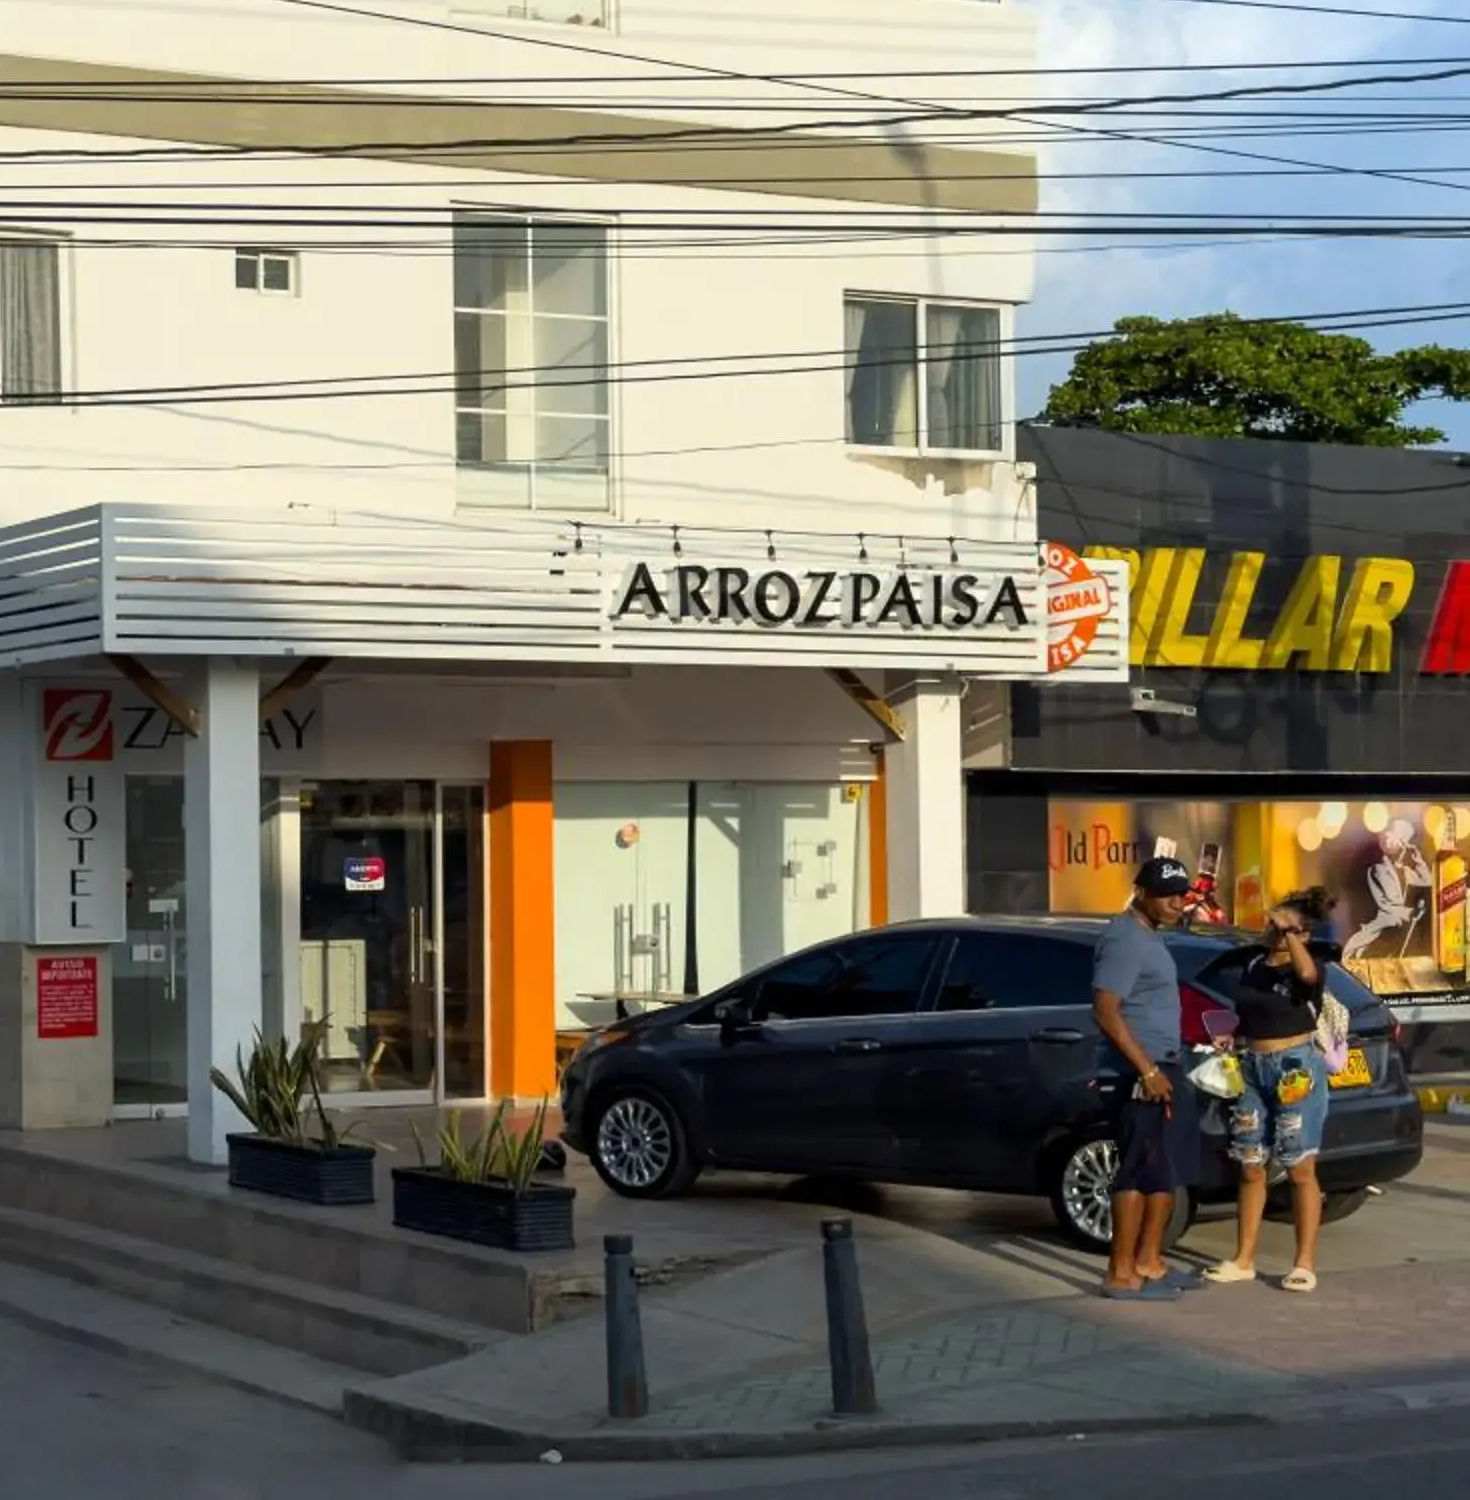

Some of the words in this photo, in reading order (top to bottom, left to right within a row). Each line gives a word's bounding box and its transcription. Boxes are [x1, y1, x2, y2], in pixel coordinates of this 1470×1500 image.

[1084, 545, 1415, 673] ILLAR
[62, 774, 99, 930] HOTEL
[1049, 824, 1087, 872] Old
